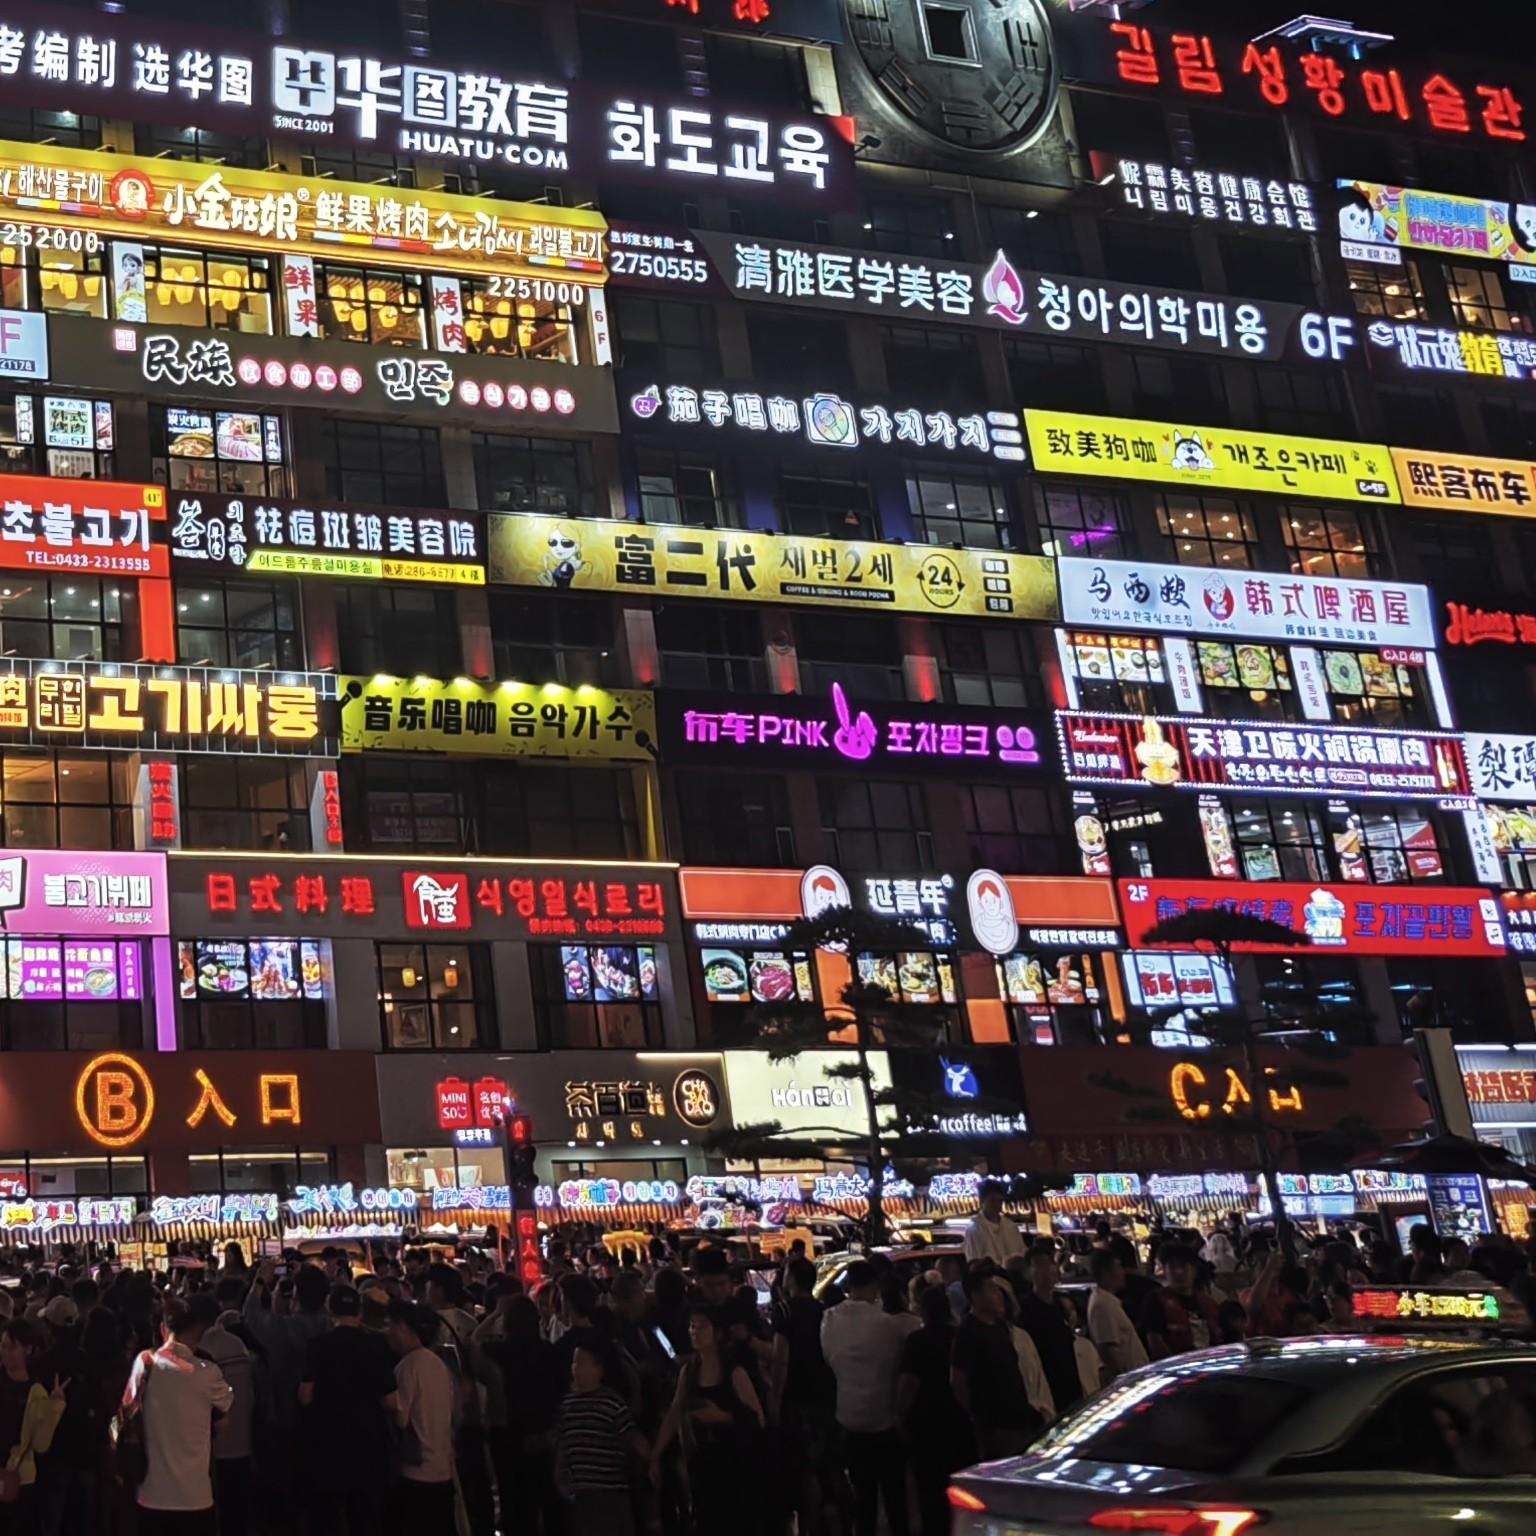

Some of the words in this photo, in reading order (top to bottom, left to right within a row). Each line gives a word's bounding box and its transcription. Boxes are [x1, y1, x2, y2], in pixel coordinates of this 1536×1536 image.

[134, 43, 254, 106] 选华图
[337, 57, 569, 144] 华图教育
[305, 117, 335, 134] 2001
[608, 98, 831, 190] 화도교육
[18, 164, 104, 206] 해산물구이
[163, 170, 299, 241] 小金姑娘
[315, 191, 429, 241] 鲜果烤肉
[529, 224, 604, 263] 과일불고기
[610, 250, 708, 283] 2750555
[282, 262, 318, 327] 鲜果
[488, 277, 584, 305] 2251000
[734, 241, 976, 316] 清雅医学美容
[433, 287, 466, 354] 烤肉
[1037, 277, 1268, 355] 청아의학미용
[1300, 312, 1355, 361] 6F
[142, 334, 239, 390] 民族
[378, 358, 454, 406] 민족
[860, 406, 990, 453] 가지가지
[1046, 427, 1158, 465] 致美狗咖
[1406, 460, 1531, 506] 熙客布车
[613, 534, 756, 595] 富二代
[927, 565, 954, 587] 24
[1243, 578, 1413, 627] 韩式啤酒屋
[363, 695, 498, 736] 音乐唱咖
[507, 701, 633, 742] 음악가수
[887, 722, 990, 758] 포차핑크
[206, 873, 376, 915] 日式料理
[866, 877, 951, 917] 延青年
[1127, 883, 1149, 901] 2F
[186, 1068, 301, 1128] 入口
[441, 1092, 467, 1105] MINI
[1172, 1063, 1210, 1119] C
